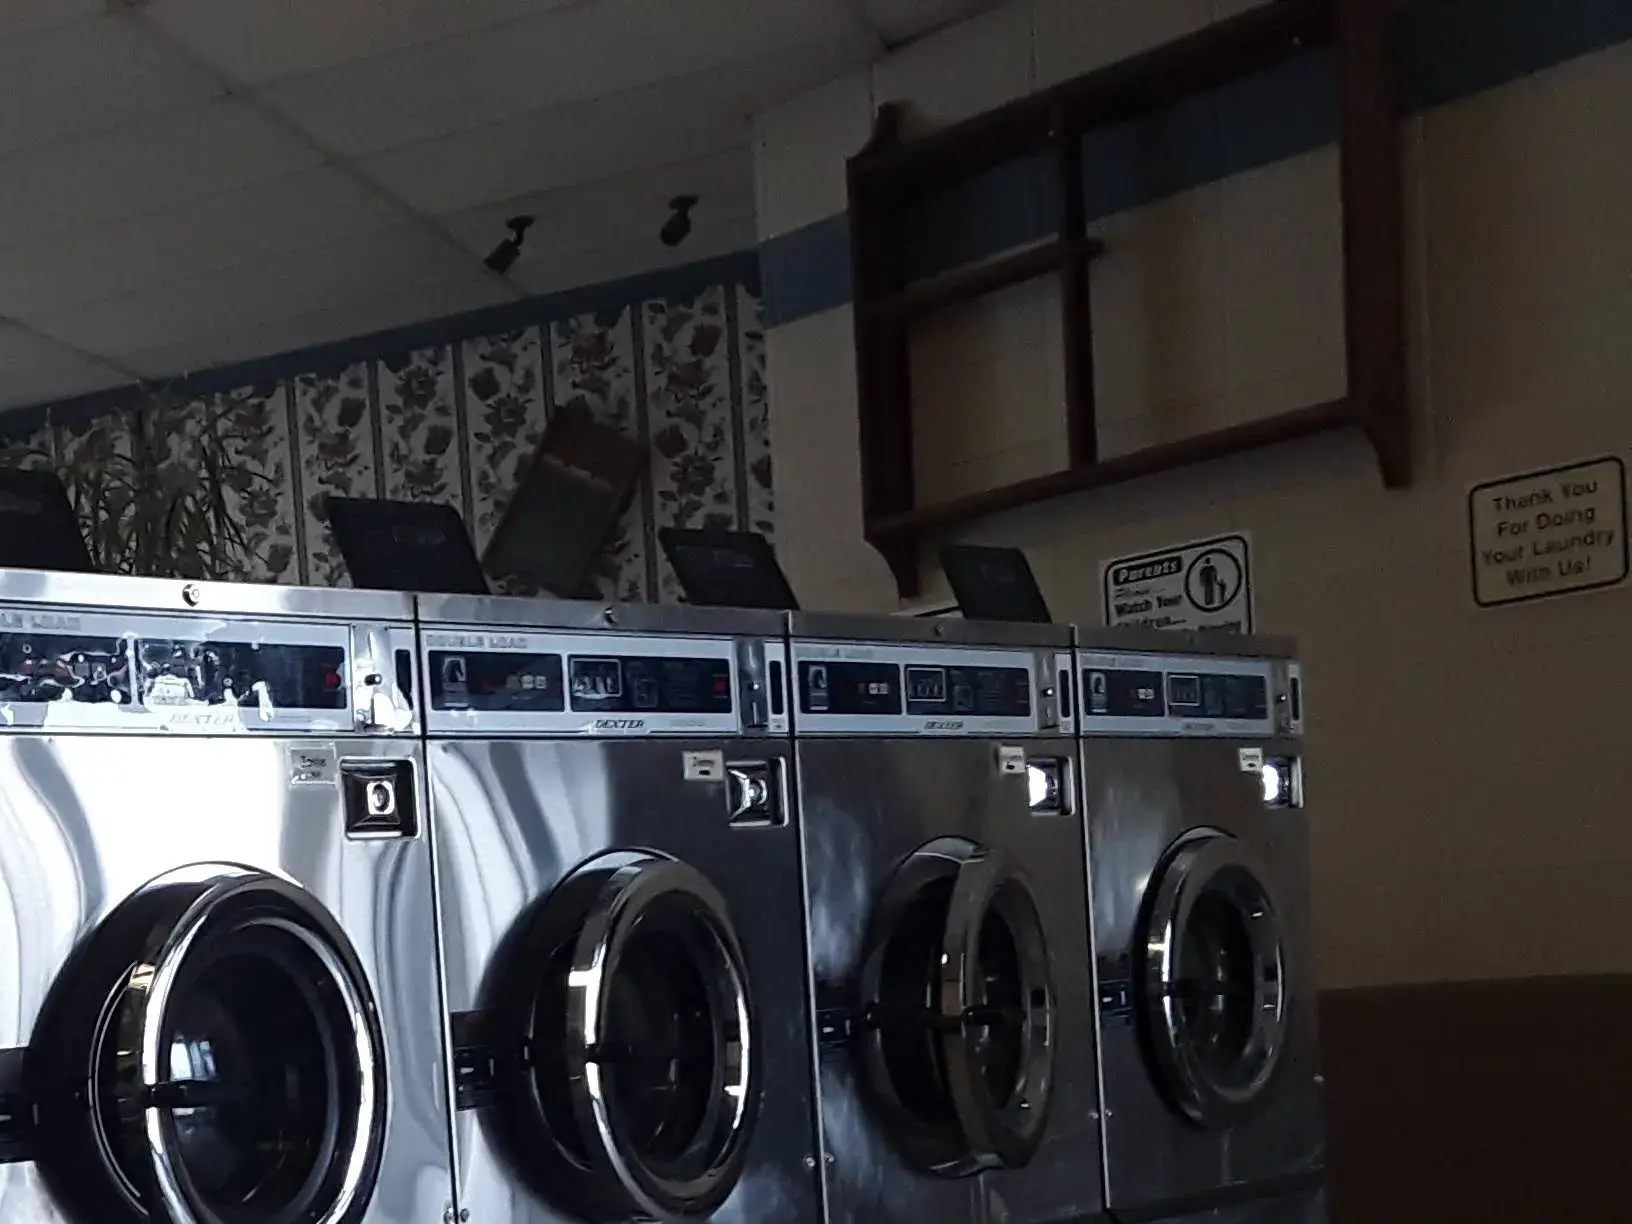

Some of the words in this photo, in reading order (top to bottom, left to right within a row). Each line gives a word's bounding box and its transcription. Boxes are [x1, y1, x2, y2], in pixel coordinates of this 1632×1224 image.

[1492, 488, 1554, 512] Thank
[1561, 480, 1598, 498] You
[1497, 520, 1529, 537] For
[1535, 507, 1596, 530] Doing
[1483, 545, 1526, 566] Your
[1532, 529, 1615, 556] Laundry
[595, 719, 645, 729] DEXTER
